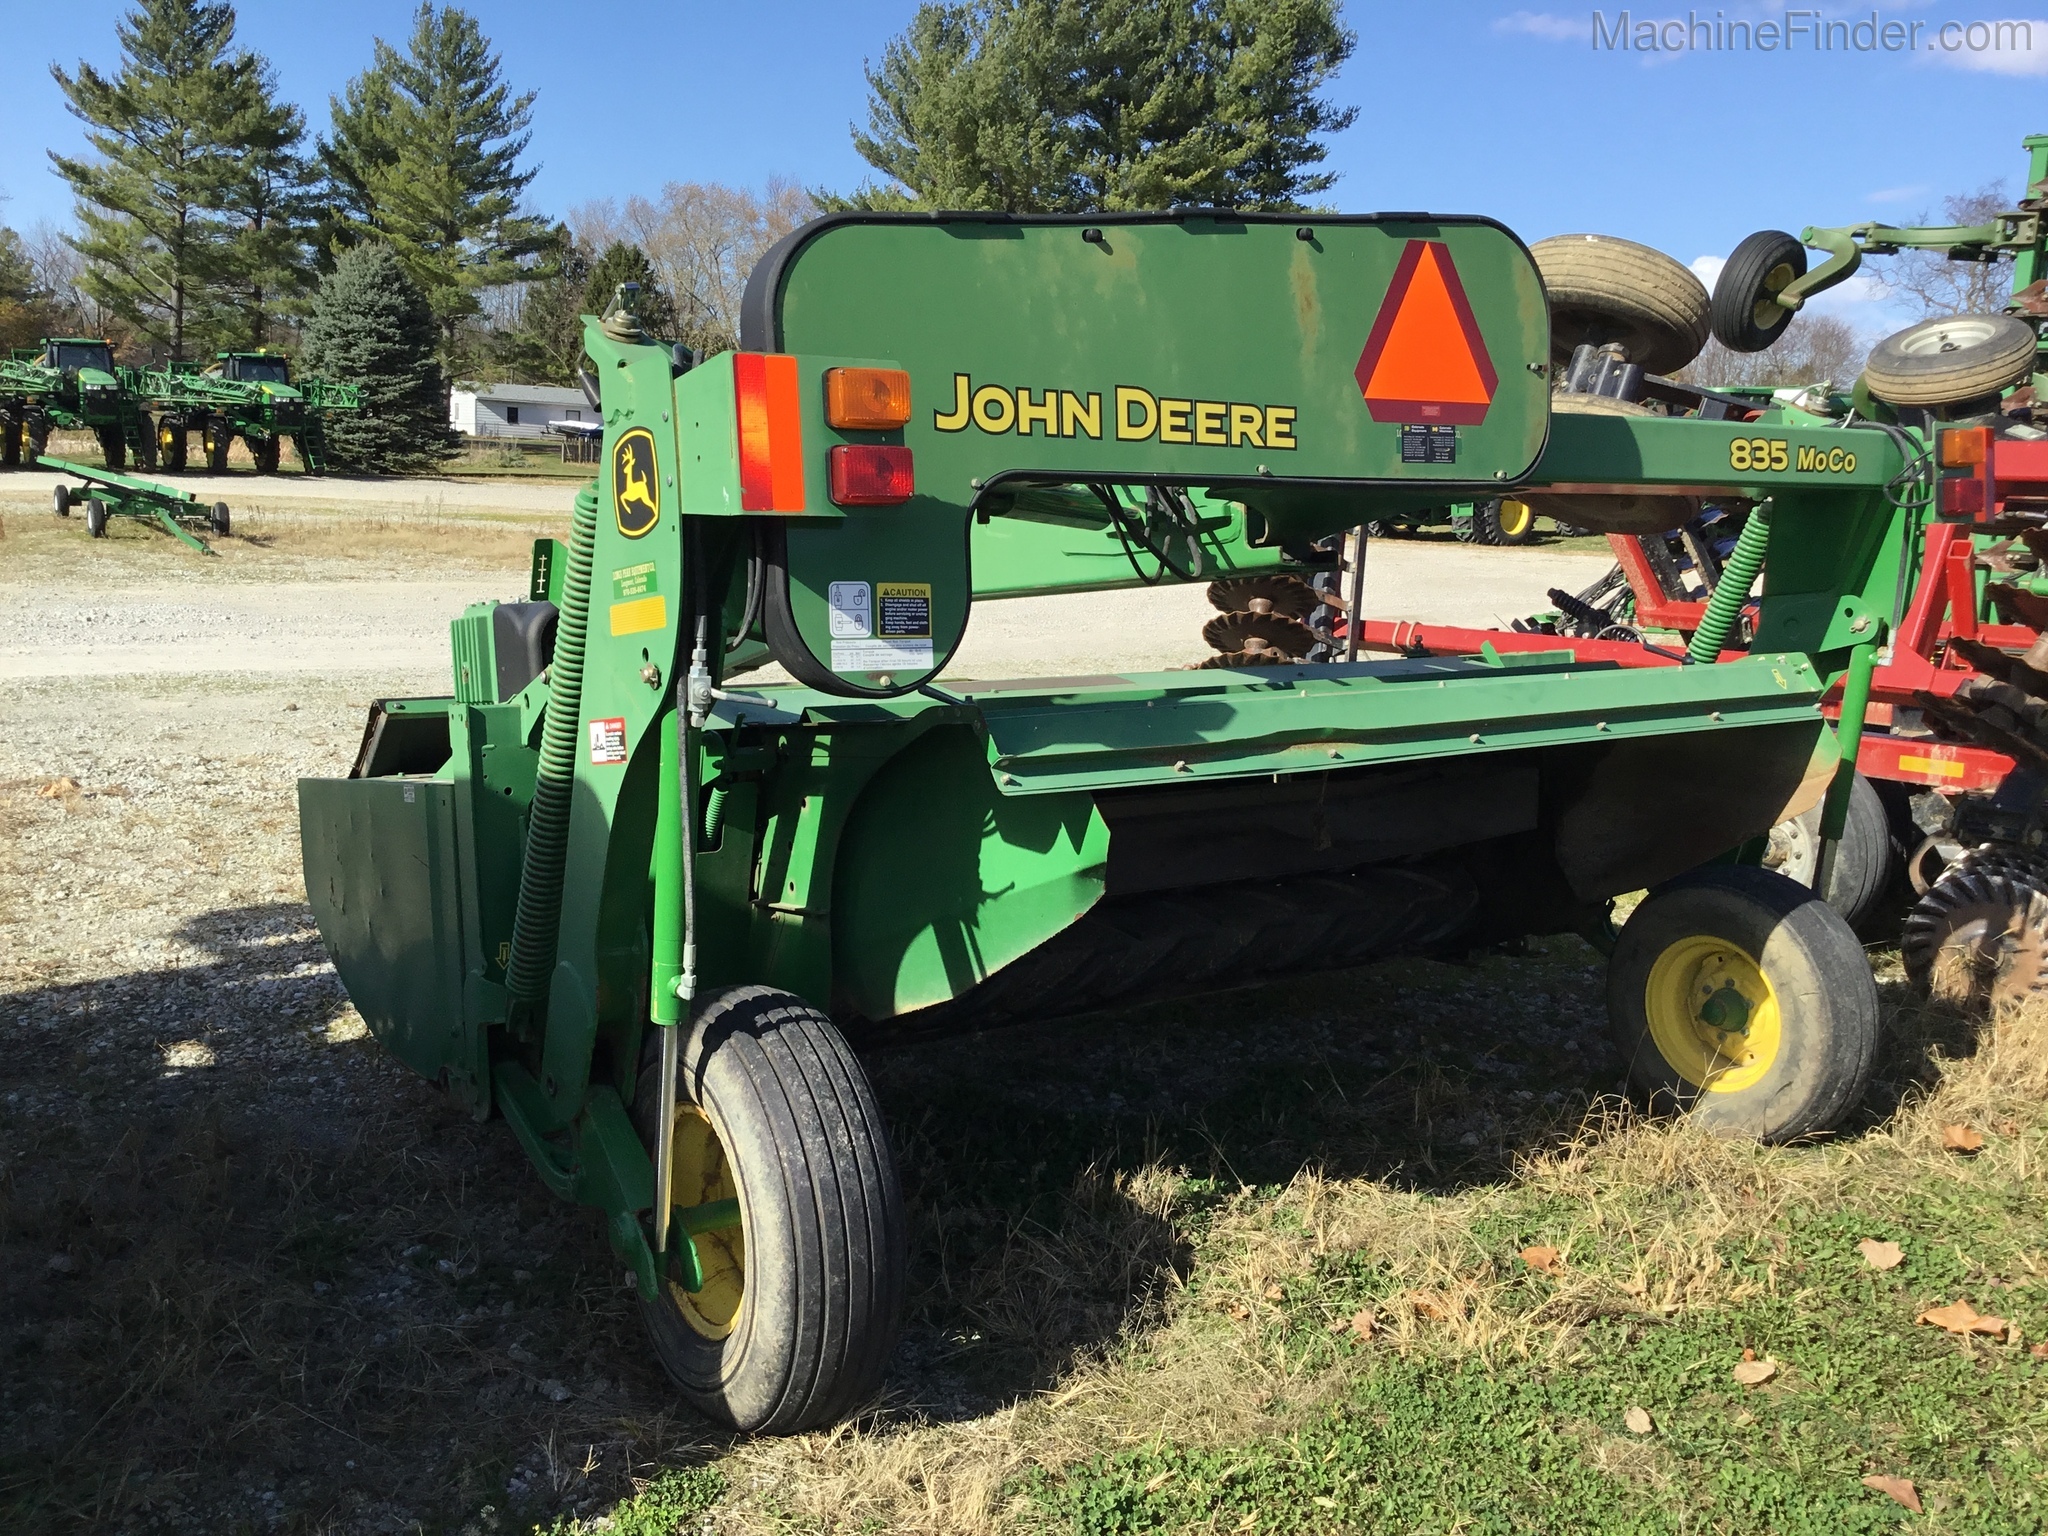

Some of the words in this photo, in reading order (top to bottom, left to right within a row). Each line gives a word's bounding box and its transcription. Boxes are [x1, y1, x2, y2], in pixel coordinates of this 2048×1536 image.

[934, 372, 1103, 440] JOHN
[1115, 384, 1298, 451] DEERE
[1729, 437, 1789, 472] 835
[1796, 445, 1857, 473] MoCo
[890, 588, 926, 597] CAUTION
